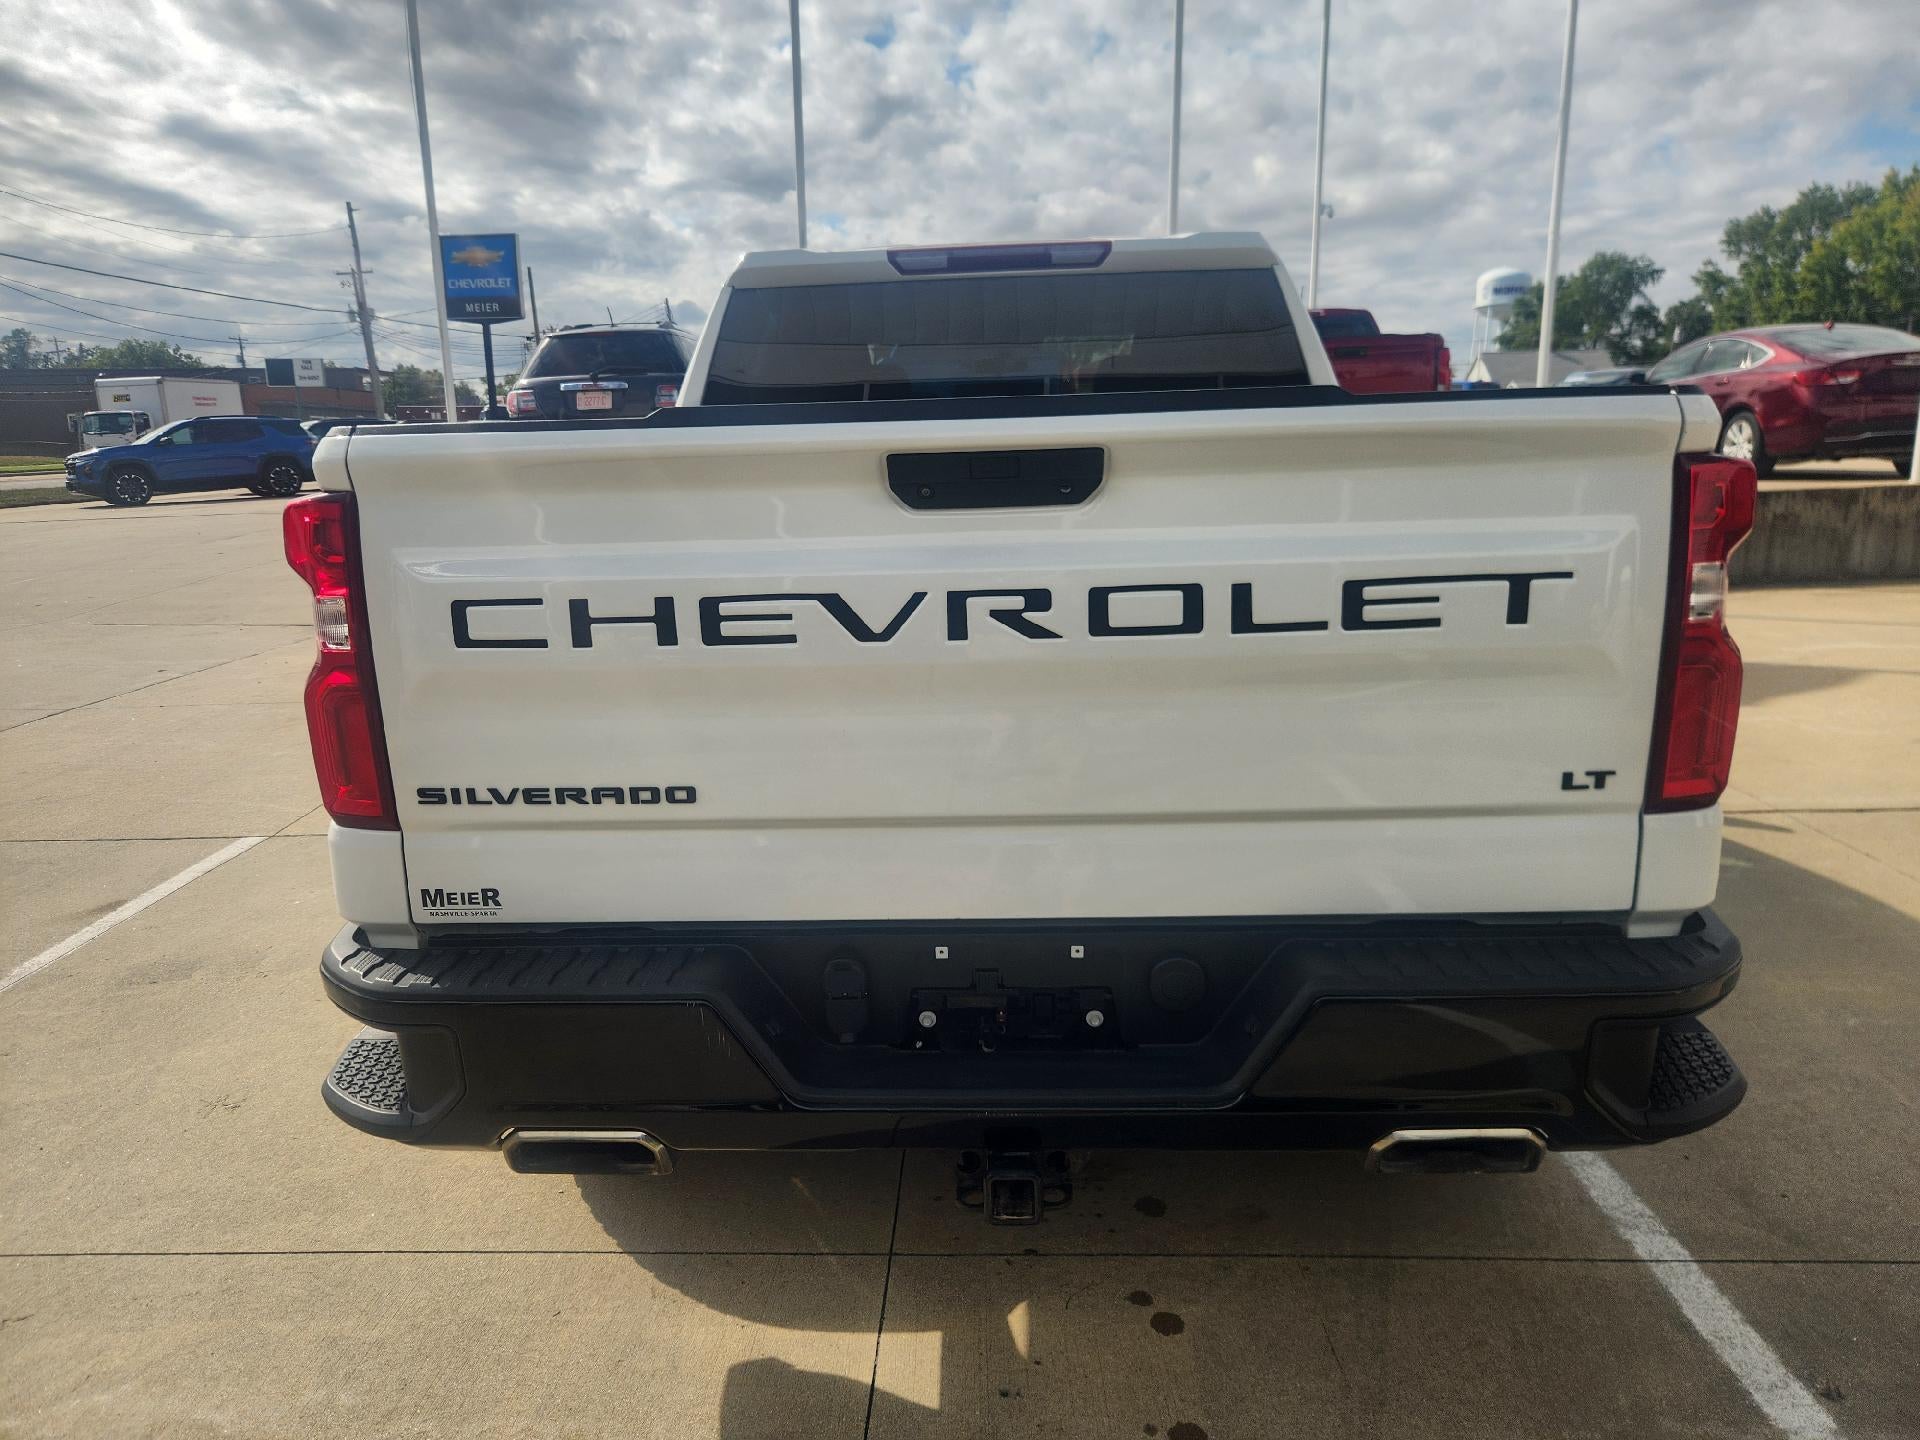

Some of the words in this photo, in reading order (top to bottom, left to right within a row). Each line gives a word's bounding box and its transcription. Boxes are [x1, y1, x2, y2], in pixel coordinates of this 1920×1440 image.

[448, 277, 512, 289] CHEVROLET
[465, 303, 500, 313] MEIER
[451, 572, 1573, 649] CHEVROLET
[1561, 770, 1617, 790] LT
[416, 786, 697, 805] SILVERADO
